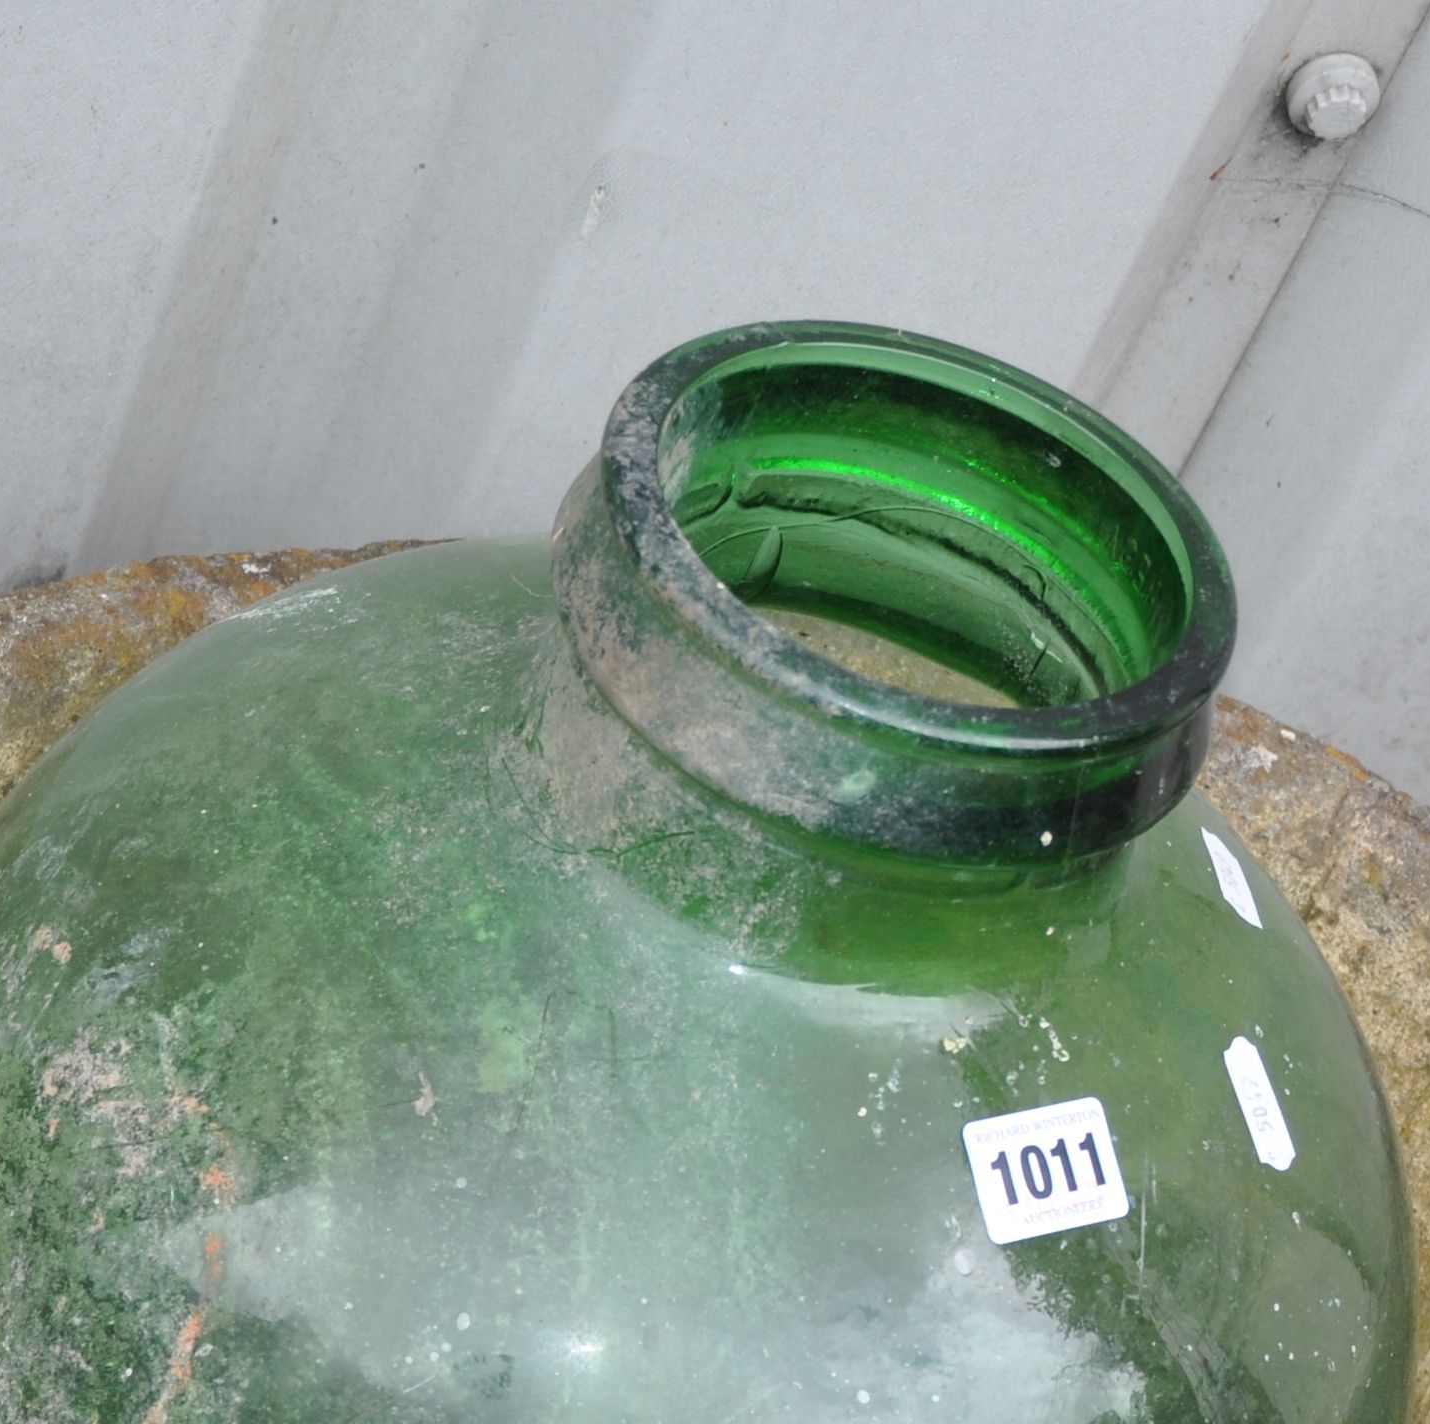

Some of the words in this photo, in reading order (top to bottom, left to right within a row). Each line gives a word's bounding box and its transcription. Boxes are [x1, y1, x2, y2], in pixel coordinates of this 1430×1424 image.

[975, 1123, 1031, 1145] RICHARD
[1032, 1108, 1101, 1131] WINTERTON
[990, 1131, 1106, 1205] 1011
[1022, 1199, 1104, 1225] AUCTIONEERS
